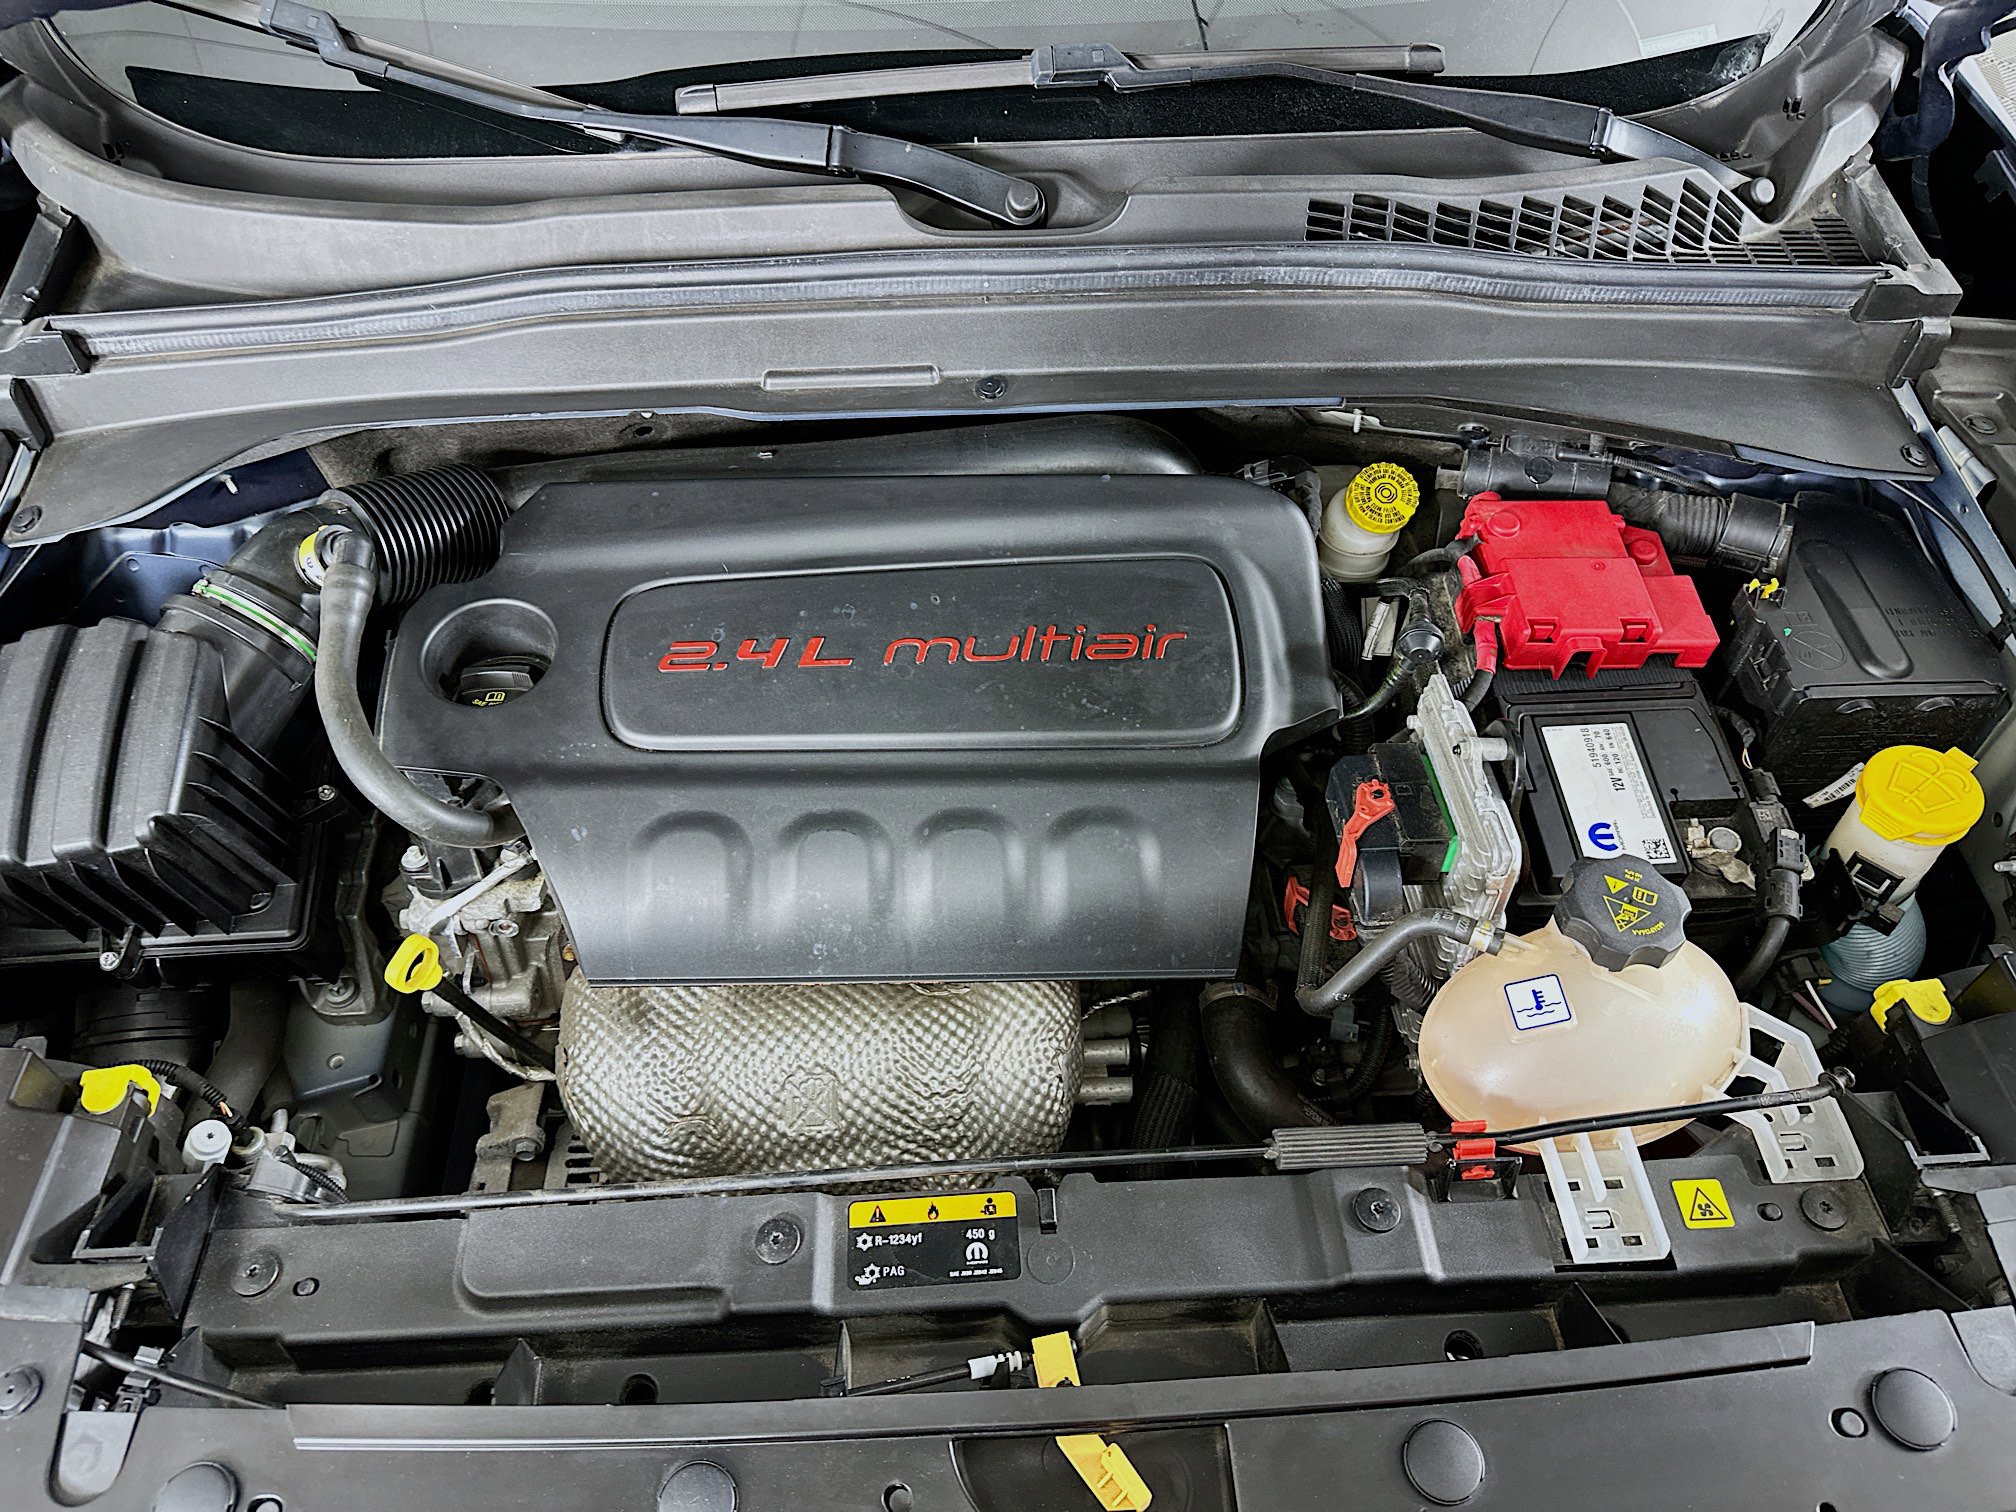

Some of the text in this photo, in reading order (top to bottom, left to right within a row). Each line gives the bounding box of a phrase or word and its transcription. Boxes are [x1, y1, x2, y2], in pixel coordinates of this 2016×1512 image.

[883, 623, 1188, 665] multiair
[1580, 727, 1602, 768] 51940918
[1612, 753, 1622, 765] 120
[1610, 777, 1626, 792] 12V
[874, 1232, 923, 1247] R-1234yf
[965, 1228, 996, 1242] 450 g
[882, 1265, 906, 1278] PAG
